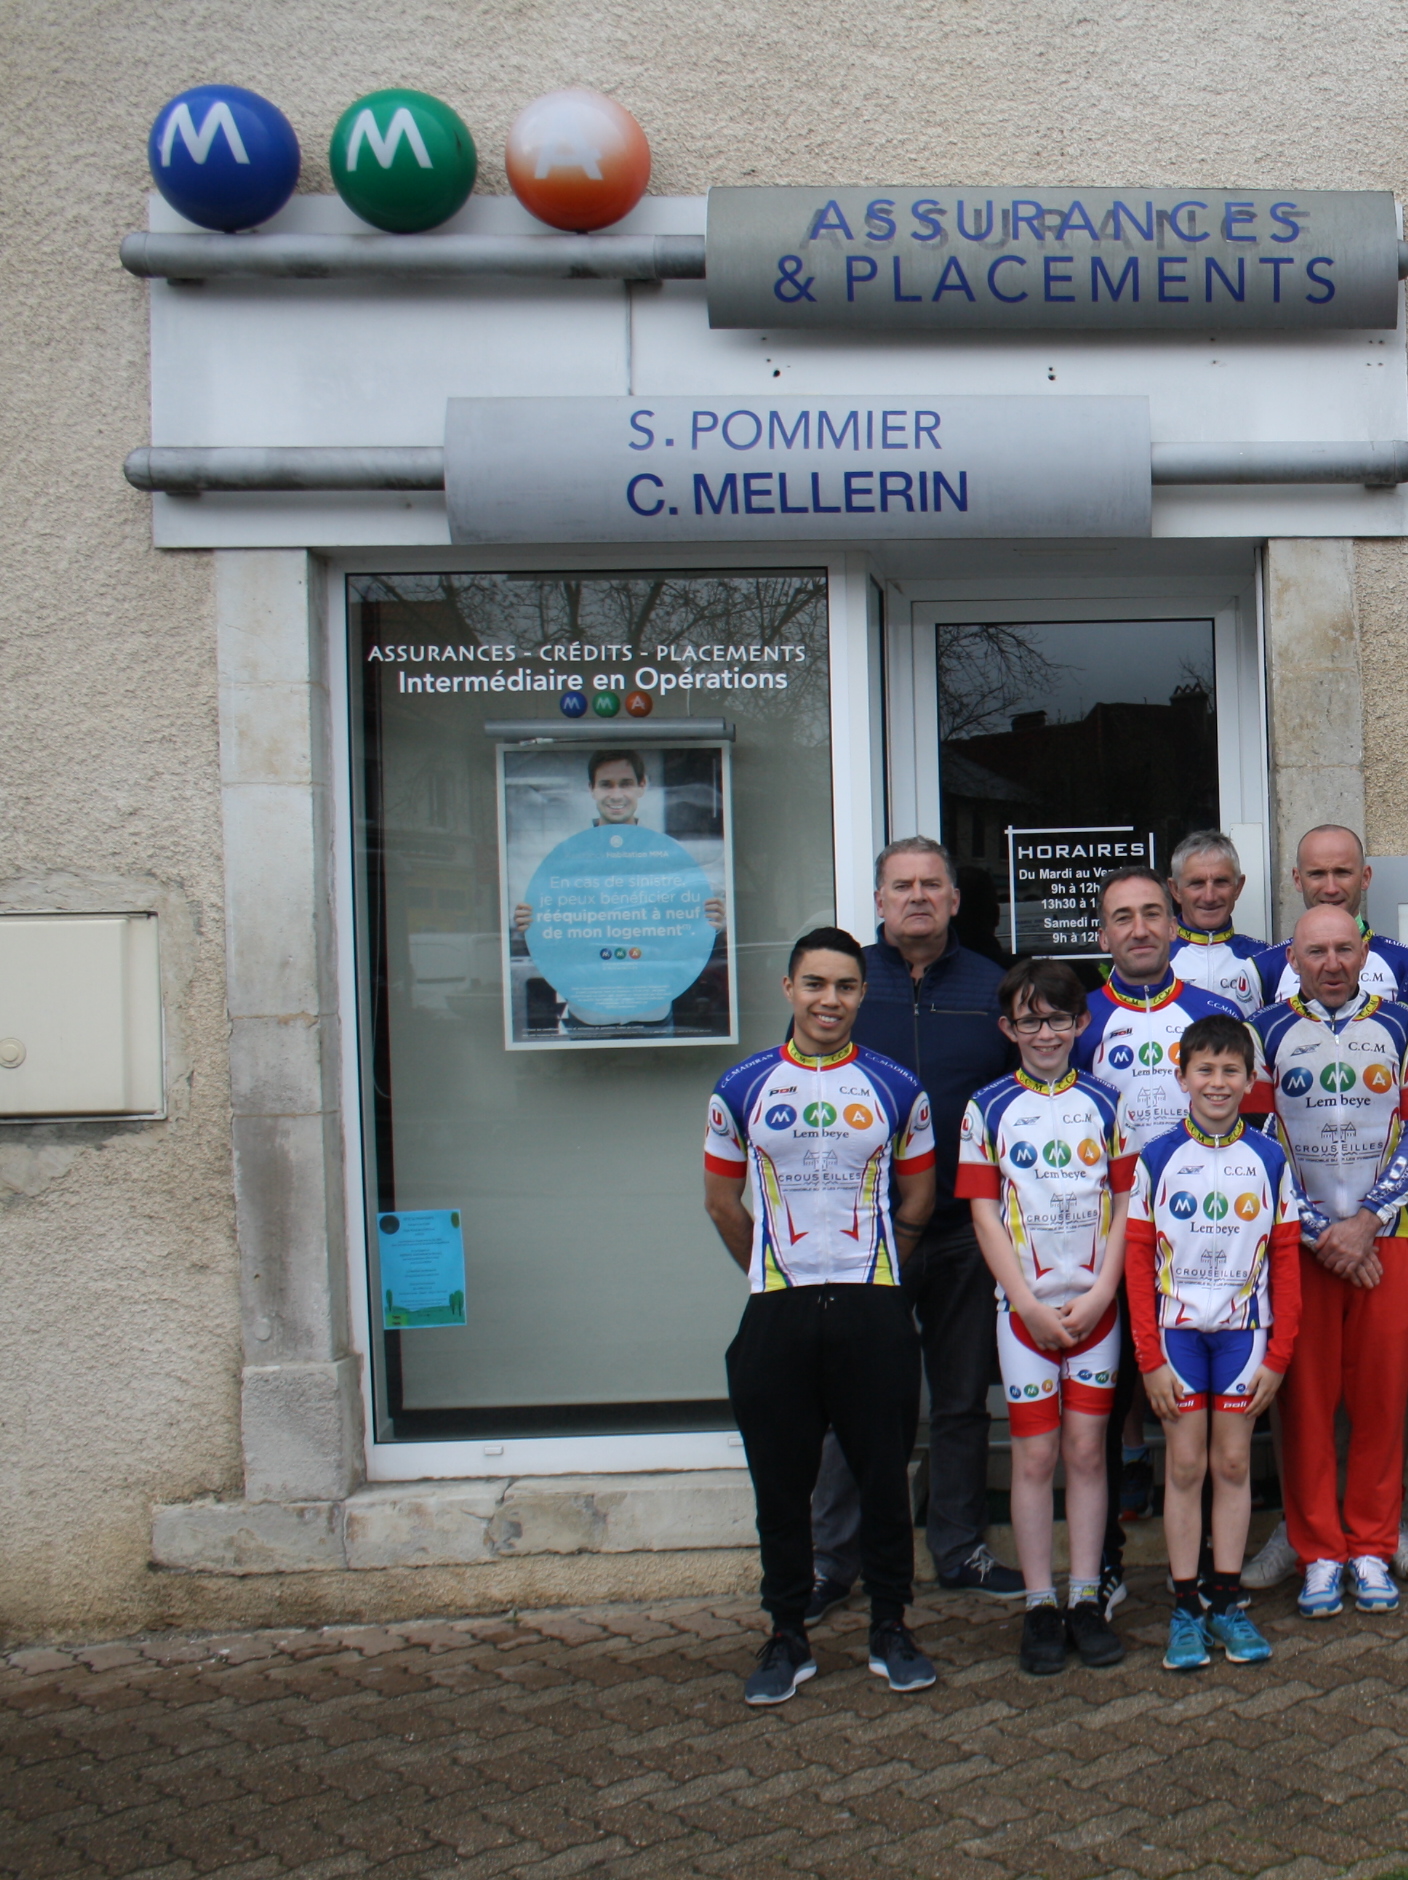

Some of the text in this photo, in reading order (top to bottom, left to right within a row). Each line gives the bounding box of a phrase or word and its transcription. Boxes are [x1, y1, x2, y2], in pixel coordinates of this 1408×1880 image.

[161, 102, 250, 168] M
[347, 108, 433, 172] M
[809, 199, 1301, 243] ASSURANCES
[774, 255, 1337, 304] & PLACEMENTS
[368, 642, 805, 662] ASSURANCES CRÉDITS PLACEMENTS
[399, 667, 787, 695] Intermédiaire en Opérations
[1018, 843, 1144, 859] HORAIRES
[1019, 869, 1035, 880] Du
[1040, 868, 1073, 879] Mardi
[1076, 869, 1090, 878] au
[551, 876, 570, 888] En
[574, 878, 600, 888] cas
[605, 876, 623, 887] de
[1051, 883, 1065, 894] 9h
[1069, 883, 1076, 893] à
[540, 890, 700, 907] je peux bénéficier du
[1041, 898, 1076, 910] 13h30
[1080, 898, 1086, 908] à
[536, 907, 700, 924] rééquipement à neuf
[1044, 917, 1088, 929] Samedi
[542, 927, 562, 939] de
[568, 928, 602, 938] mon
[1053, 932, 1067, 943] 9h
[1071, 932, 1078, 942] à
[1295, 1142, 1383, 1153] CROUSEILLES
[1175, 1267, 1248, 1278] CROUSEILLES
